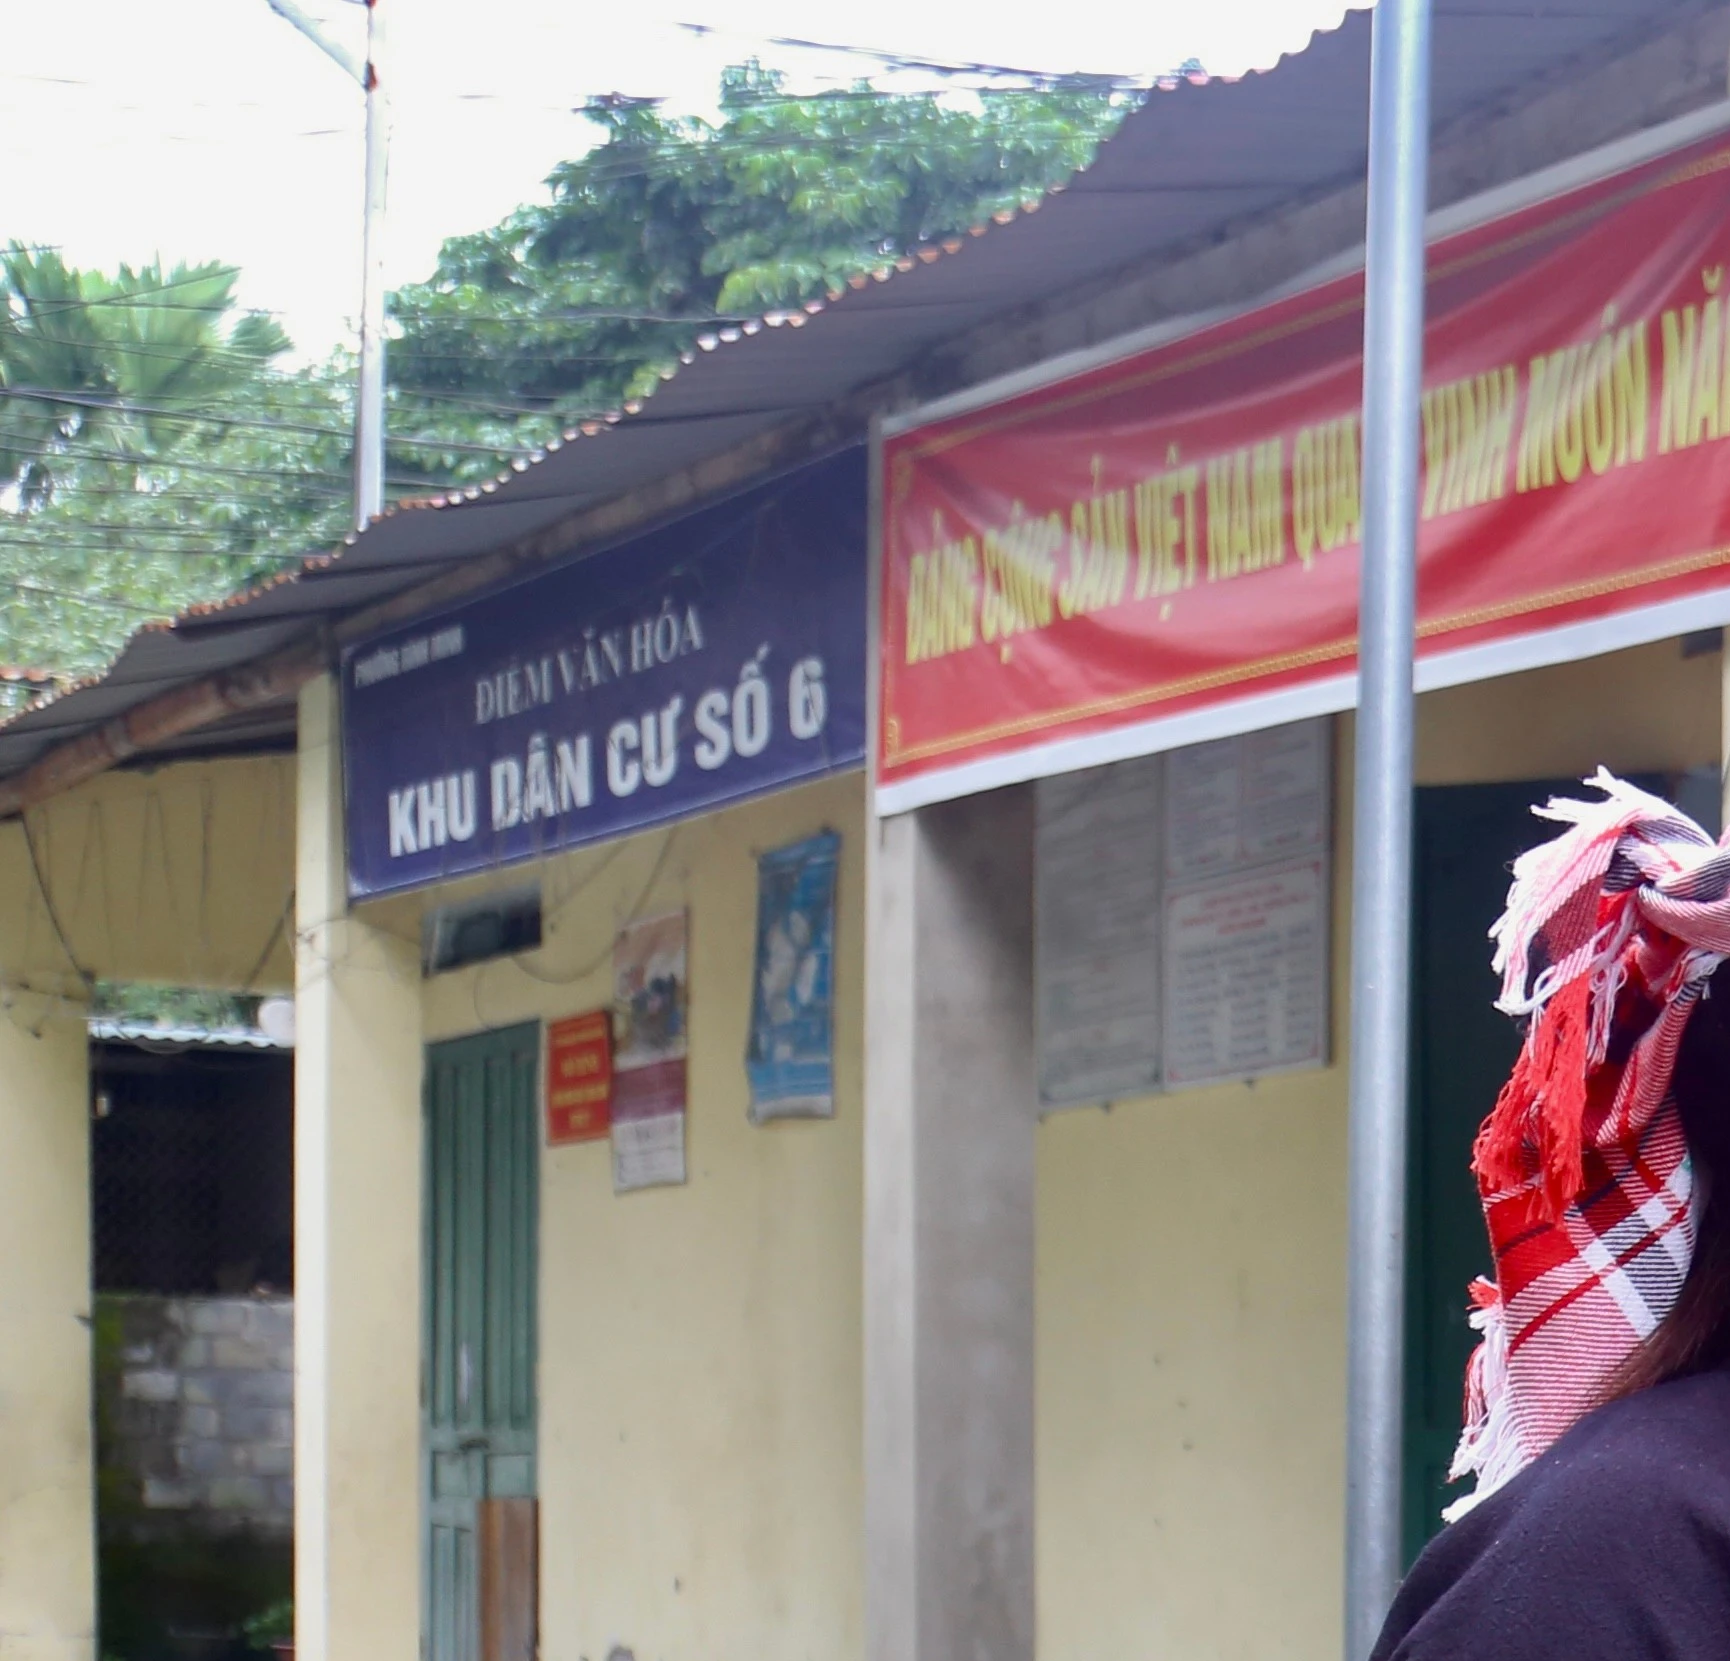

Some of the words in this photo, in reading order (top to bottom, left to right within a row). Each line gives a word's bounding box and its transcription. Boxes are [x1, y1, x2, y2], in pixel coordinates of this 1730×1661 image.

[1058, 453, 1127, 620] SẢN
[1133, 440, 1199, 622] VIỆT
[1206, 436, 1283, 585] NAM
[1293, 413, 1362, 573] QUA
[1421, 362, 1516, 521] VINH
[1516, 302, 1649, 493] MUÔN
[388, 768, 477, 858] KHU
[490, 733, 593, 832] DÂN
[606, 696, 684, 798] CƯ
[694, 642, 772, 770] SỐ
[788, 656, 828, 740] 6
[557, 625, 624, 694] VĂN
[631, 597, 704, 674] HÓA
